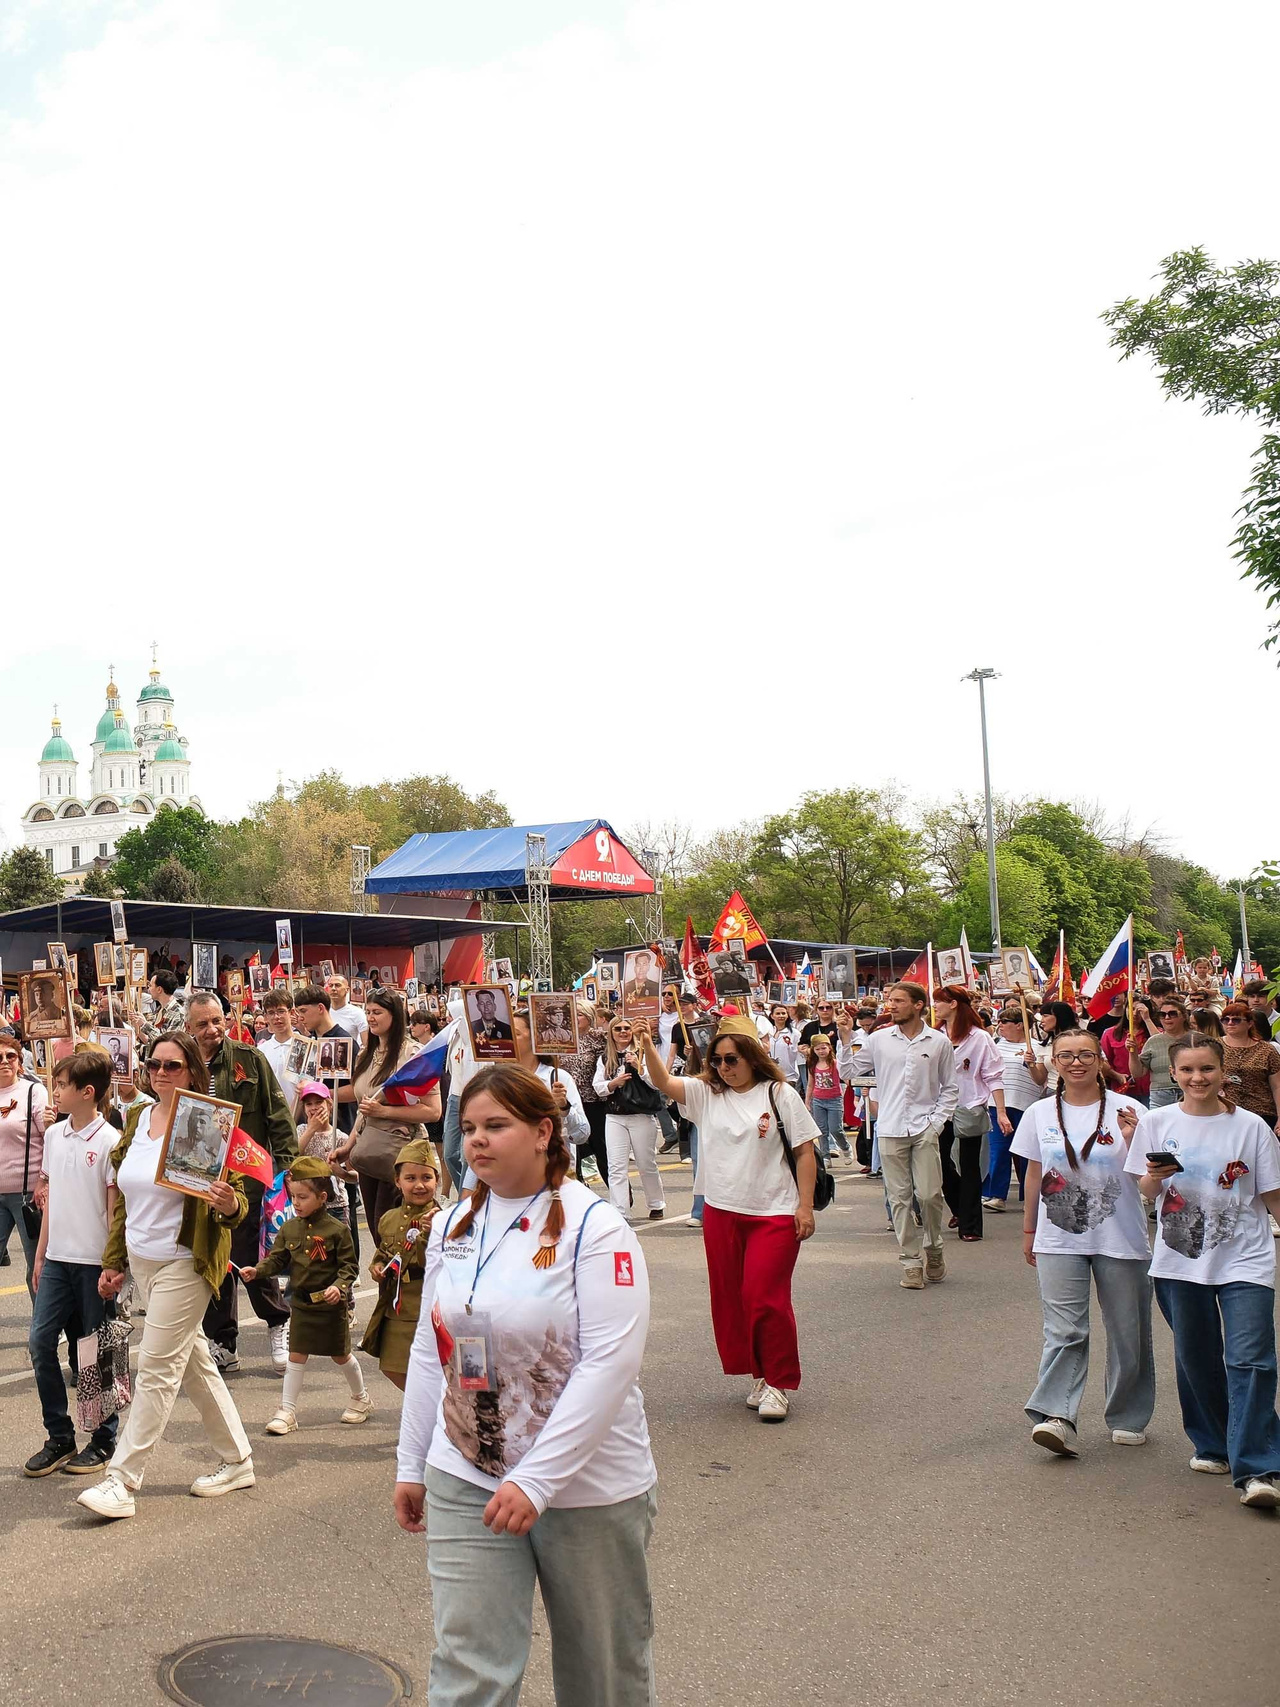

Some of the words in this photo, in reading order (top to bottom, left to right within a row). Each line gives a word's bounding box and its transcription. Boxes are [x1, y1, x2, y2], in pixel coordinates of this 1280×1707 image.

[595, 830, 610, 861] 9
[572, 868, 578, 880] С
[579, 870, 601, 882] ДНЕМ
[603, 871, 635, 886] ПОБЕДЫ!
